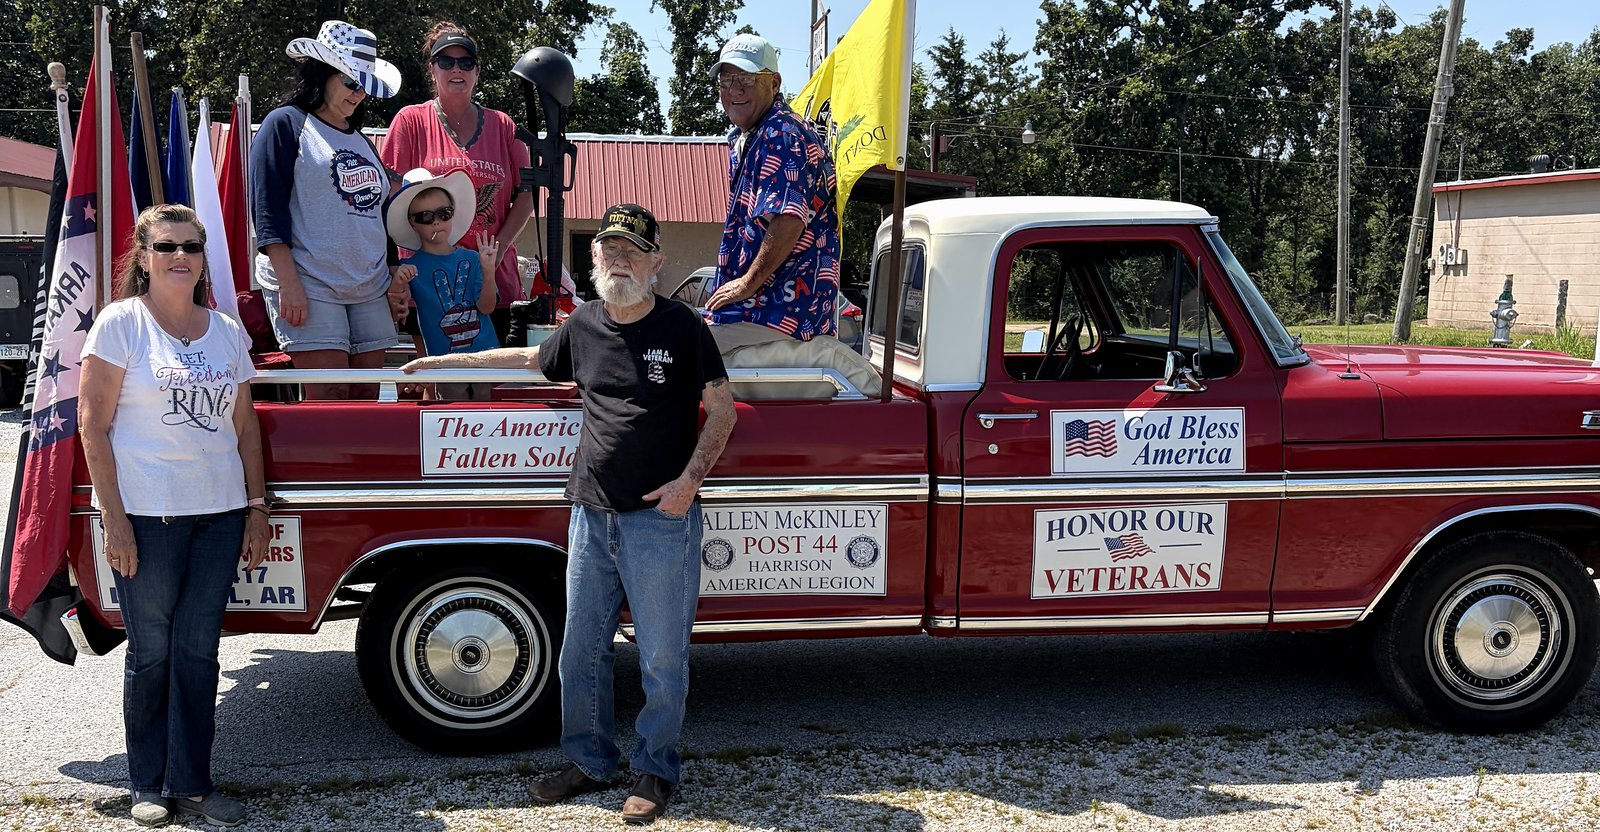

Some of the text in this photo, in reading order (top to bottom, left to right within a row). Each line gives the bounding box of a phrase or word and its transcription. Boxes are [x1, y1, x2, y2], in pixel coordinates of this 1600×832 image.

[341, 169, 378, 188] AMERICAN
[430, 156, 506, 179] UNITED STATES
[177, 351, 205, 366] LET
[643, 354, 673, 364] VETERAN
[161, 383, 233, 432] RING
[437, 416, 580, 438] The Americ
[1124, 415, 1240, 440] God Bless
[436, 447, 517, 469] Fallen
[1131, 441, 1232, 466] America
[702, 509, 882, 531] ALLEN McKINLEY
[1046, 509, 1215, 543] HONOR OUR
[743, 534, 838, 555] POST 44
[748, 559, 832, 572] HARRISON
[704, 575, 876, 592] AMERICAN LEGION
[1043, 562, 1212, 594] VETERANS
[260, 586, 296, 604] AR
